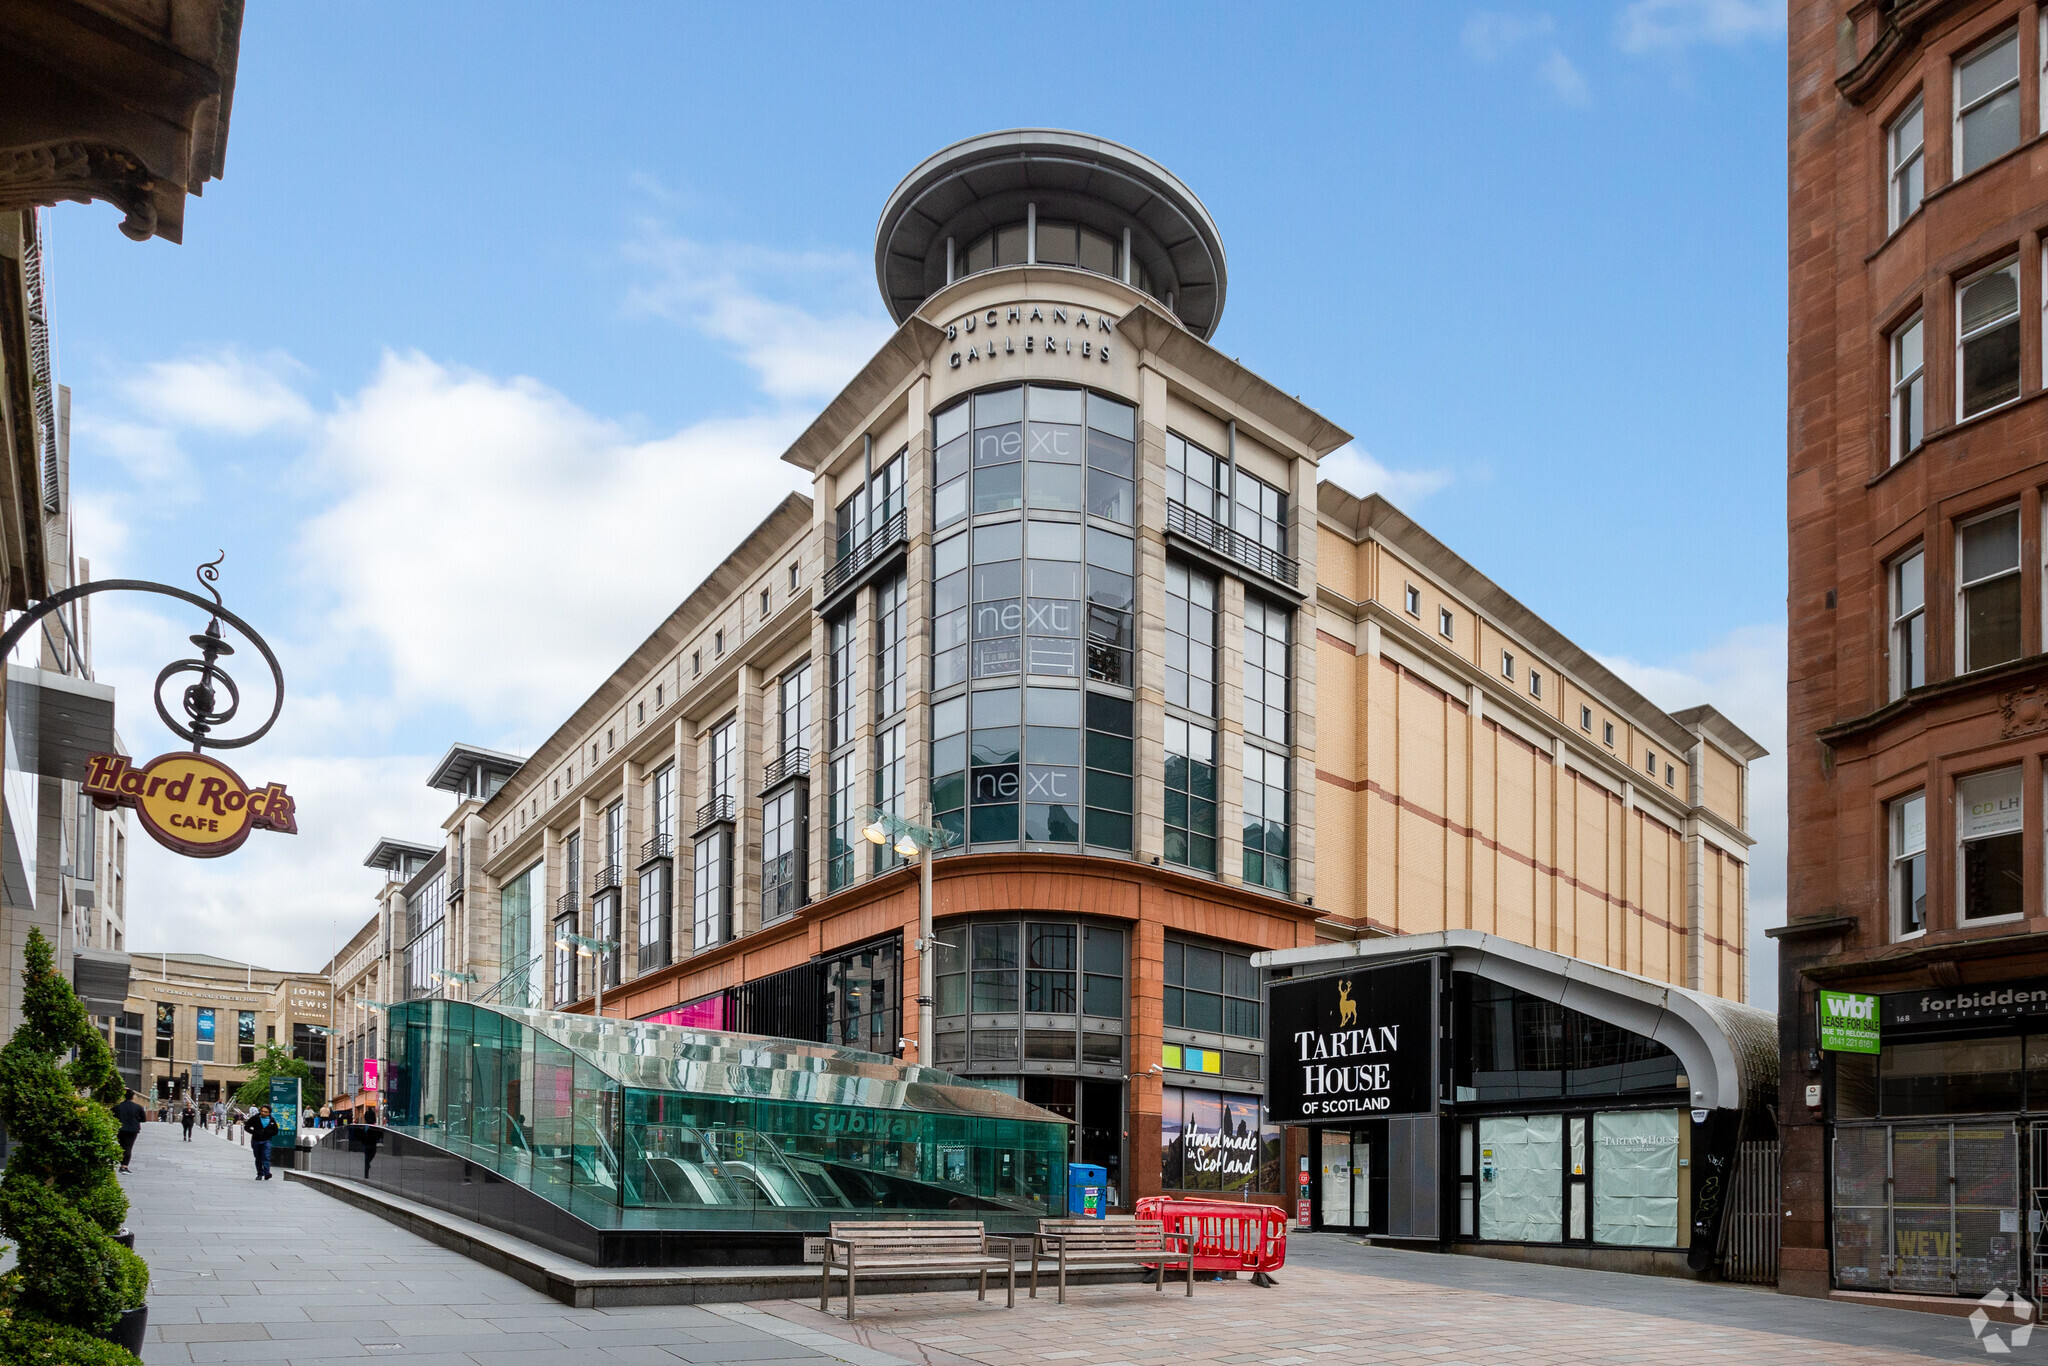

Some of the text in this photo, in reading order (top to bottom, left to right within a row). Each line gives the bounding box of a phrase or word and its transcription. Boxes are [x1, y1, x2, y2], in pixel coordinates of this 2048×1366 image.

[947, 305, 1112, 341] BUCHANAN
[949, 335, 1110, 369] GALLERIES
[980, 430, 1069, 459] next
[978, 603, 1069, 633] next
[88, 756, 290, 825] Hard Rock
[976, 769, 1067, 798] next
[169, 813, 219, 832] CAFE
[290, 1000, 328, 1009] LEWIS
[293, 988, 325, 997] JOHN
[1920, 989, 2048, 1012] forbidden
[1827, 995, 1874, 1019] wbf
[1822, 1016, 1879, 1031] LEASE FOR SALE
[1822, 1027, 1880, 1039] DUE TO RELOCATION
[1294, 1024, 1400, 1061] TARTAN
[1829, 1036, 1873, 1048] 0141 221 6161
[1302, 1063, 1390, 1096] HOUSE
[1302, 1097, 1390, 1114] OF SCOTLAND
[812, 1110, 923, 1143] subway
[1185, 1123, 1257, 1151] Handmade
[1603, 1135, 1679, 1146] TARTAN HOUSE
[1187, 1148, 1254, 1174] in Scotland
